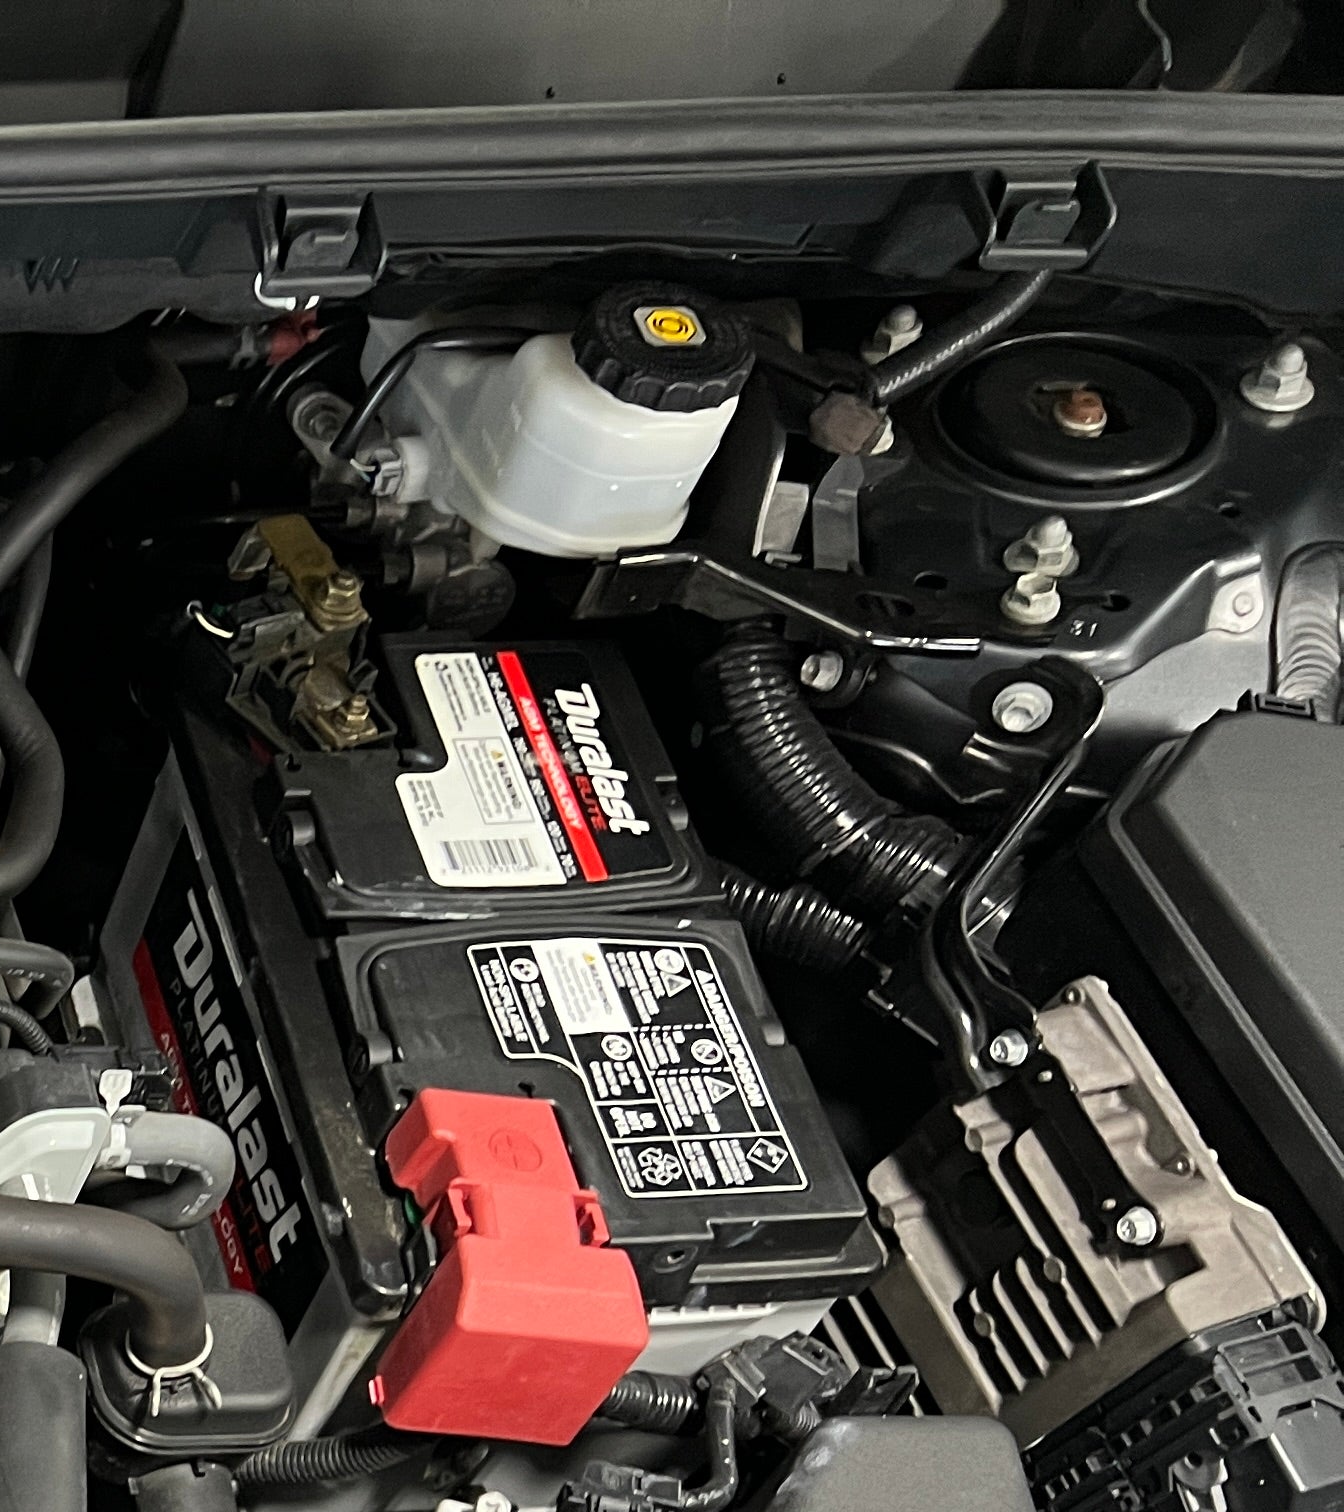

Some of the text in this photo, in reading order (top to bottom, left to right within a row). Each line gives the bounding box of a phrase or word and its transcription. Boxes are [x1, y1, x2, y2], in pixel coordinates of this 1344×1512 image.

[519, 696, 541, 732] AGM
[534, 732, 582, 829] TECHNOLOGY
[555, 682, 650, 836] Duralast
[575, 774, 607, 831] ELITE
[169, 976, 227, 1124] PLATINU
[173, 888, 301, 1264] Duralast
[704, 983, 765, 1108] DANGER/POISON
